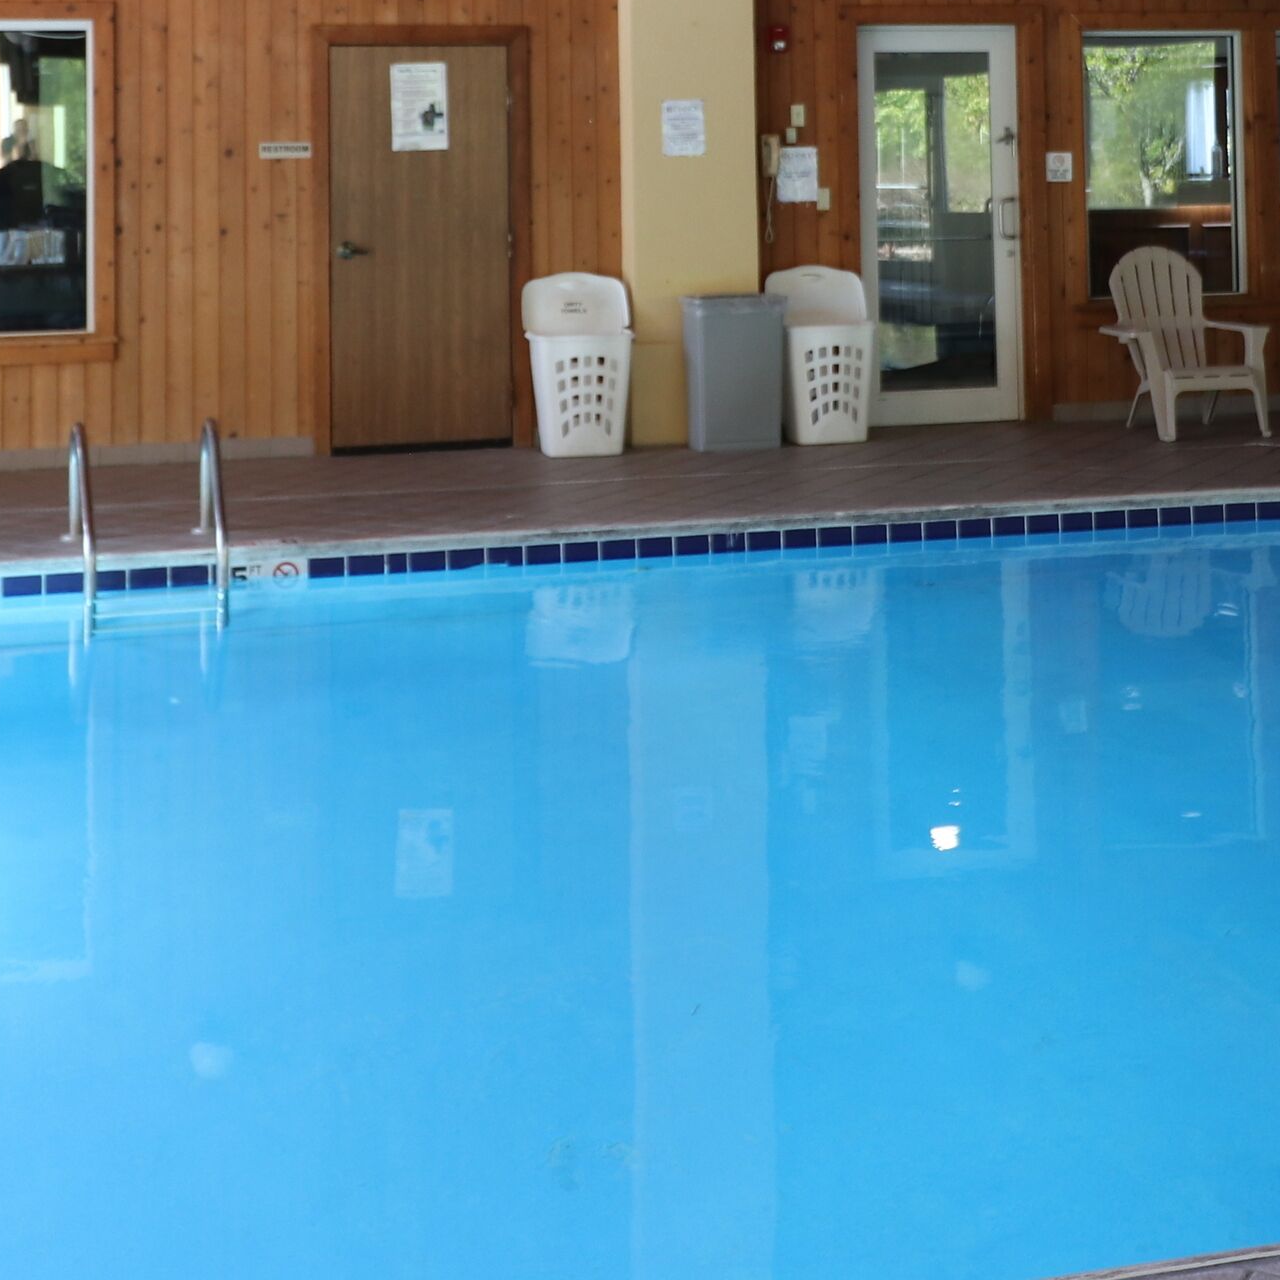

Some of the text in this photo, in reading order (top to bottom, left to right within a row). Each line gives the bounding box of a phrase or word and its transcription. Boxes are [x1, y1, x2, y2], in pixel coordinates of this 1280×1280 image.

[261, 144, 309, 153] RESTROOM
[231, 565, 262, 581] 5 FT
